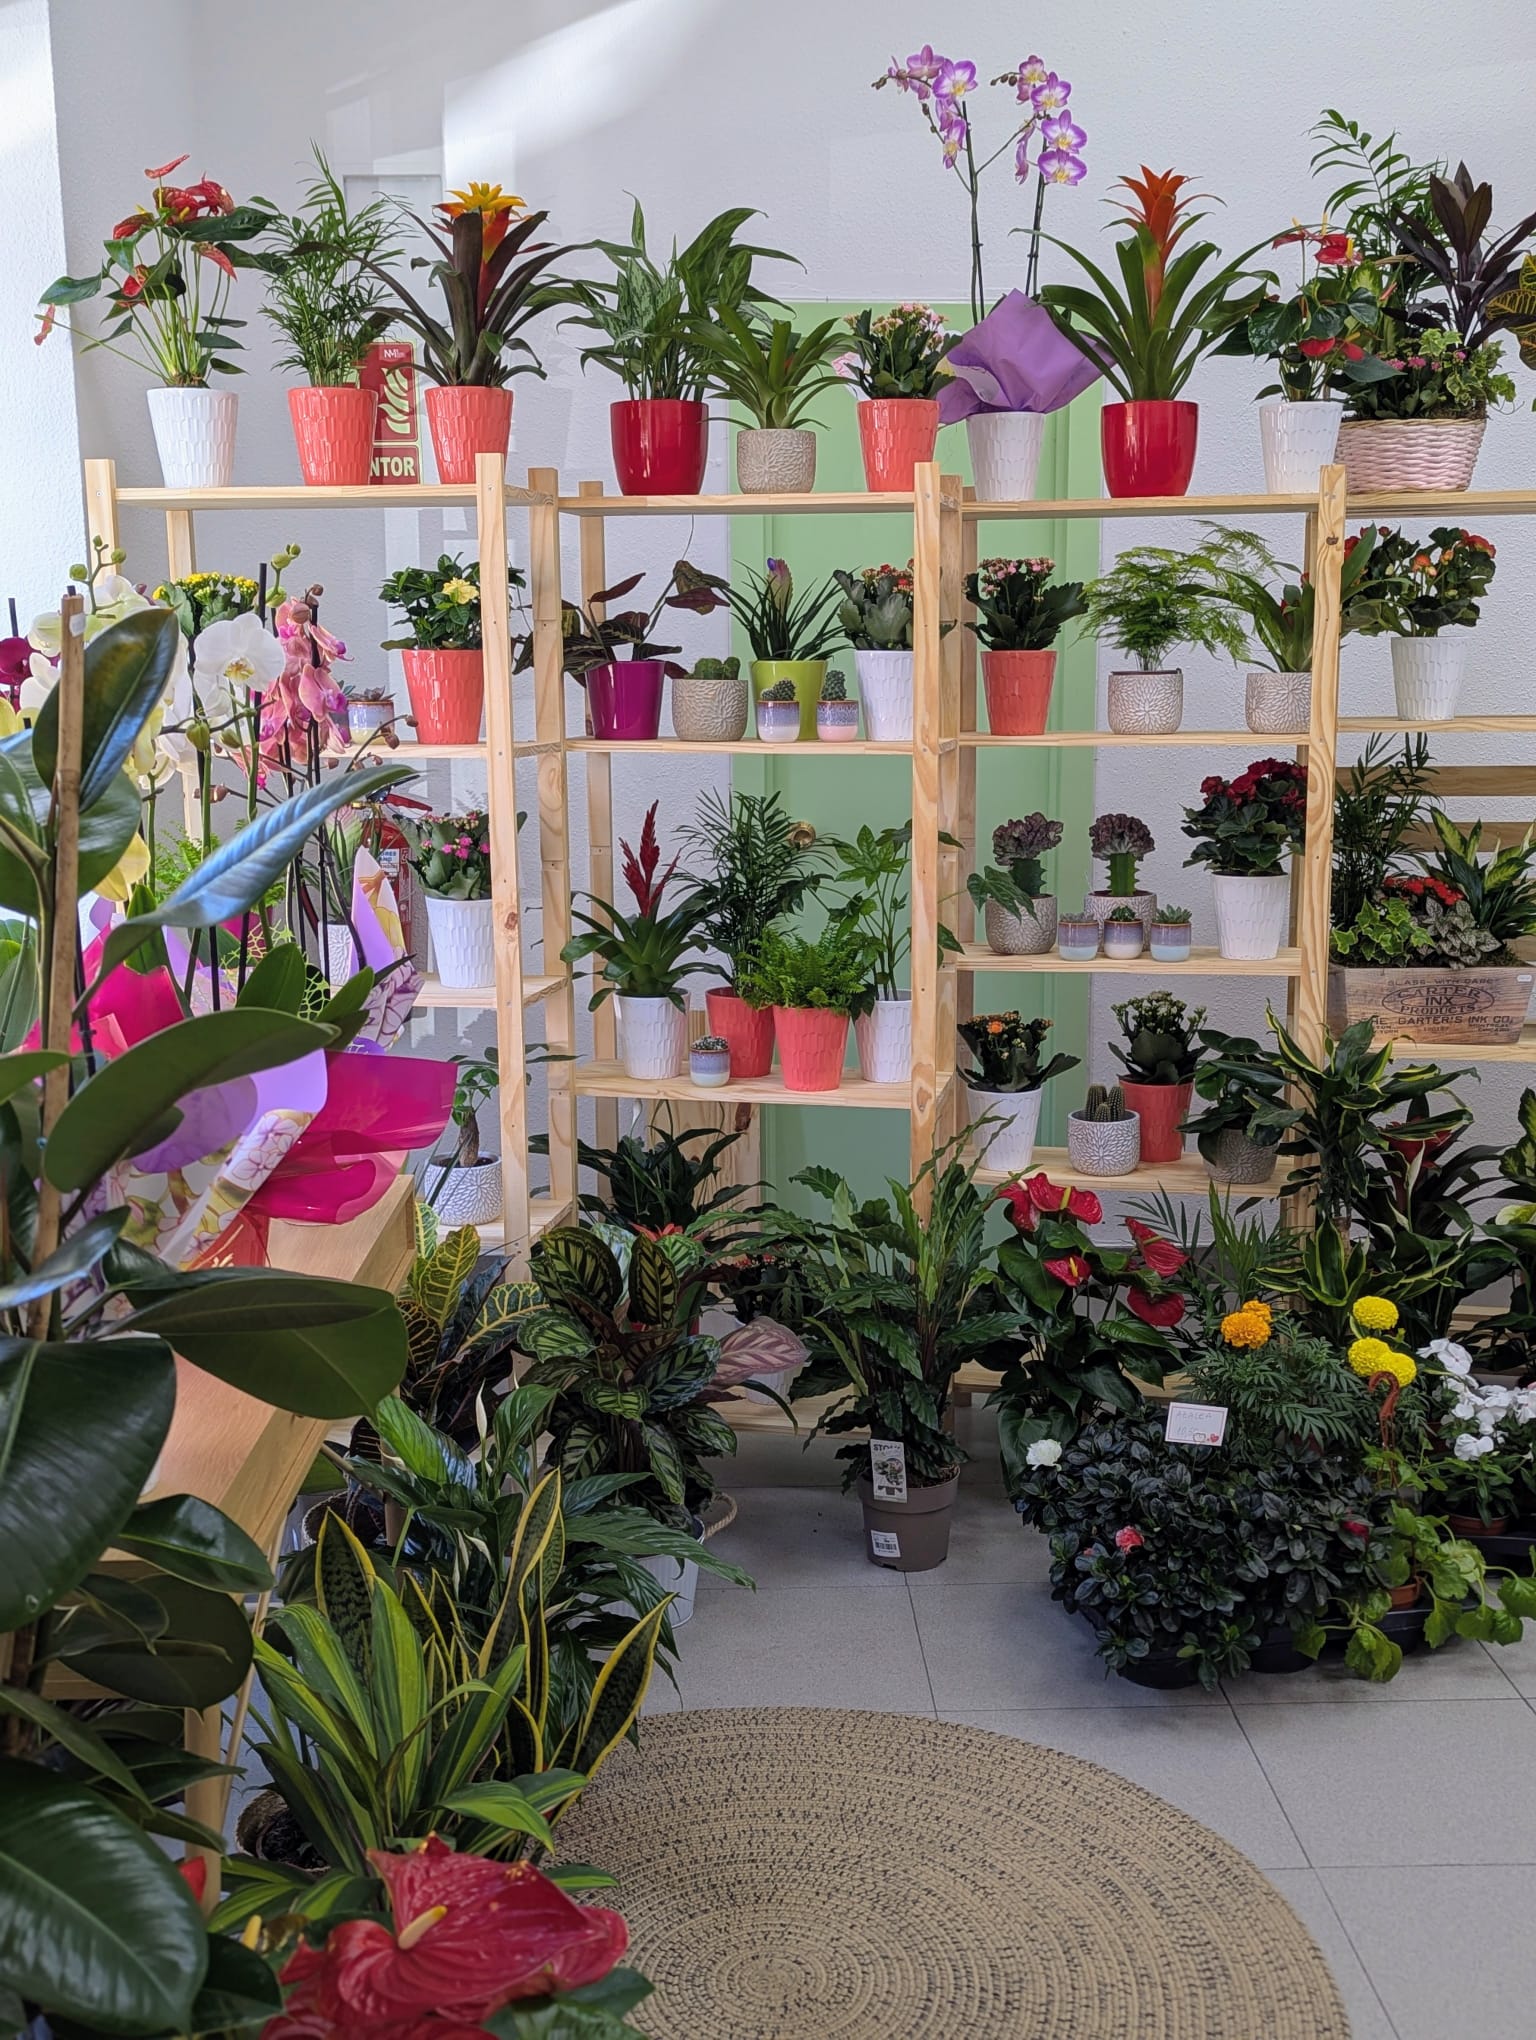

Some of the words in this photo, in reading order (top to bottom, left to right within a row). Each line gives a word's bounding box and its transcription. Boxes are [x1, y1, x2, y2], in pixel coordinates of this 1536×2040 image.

[370, 456, 416, 477] NTOR
[1398, 986, 1481, 999] CARTER
[1425, 996, 1454, 1006] INX
[1400, 1004, 1476, 1015] PRODUCTS
